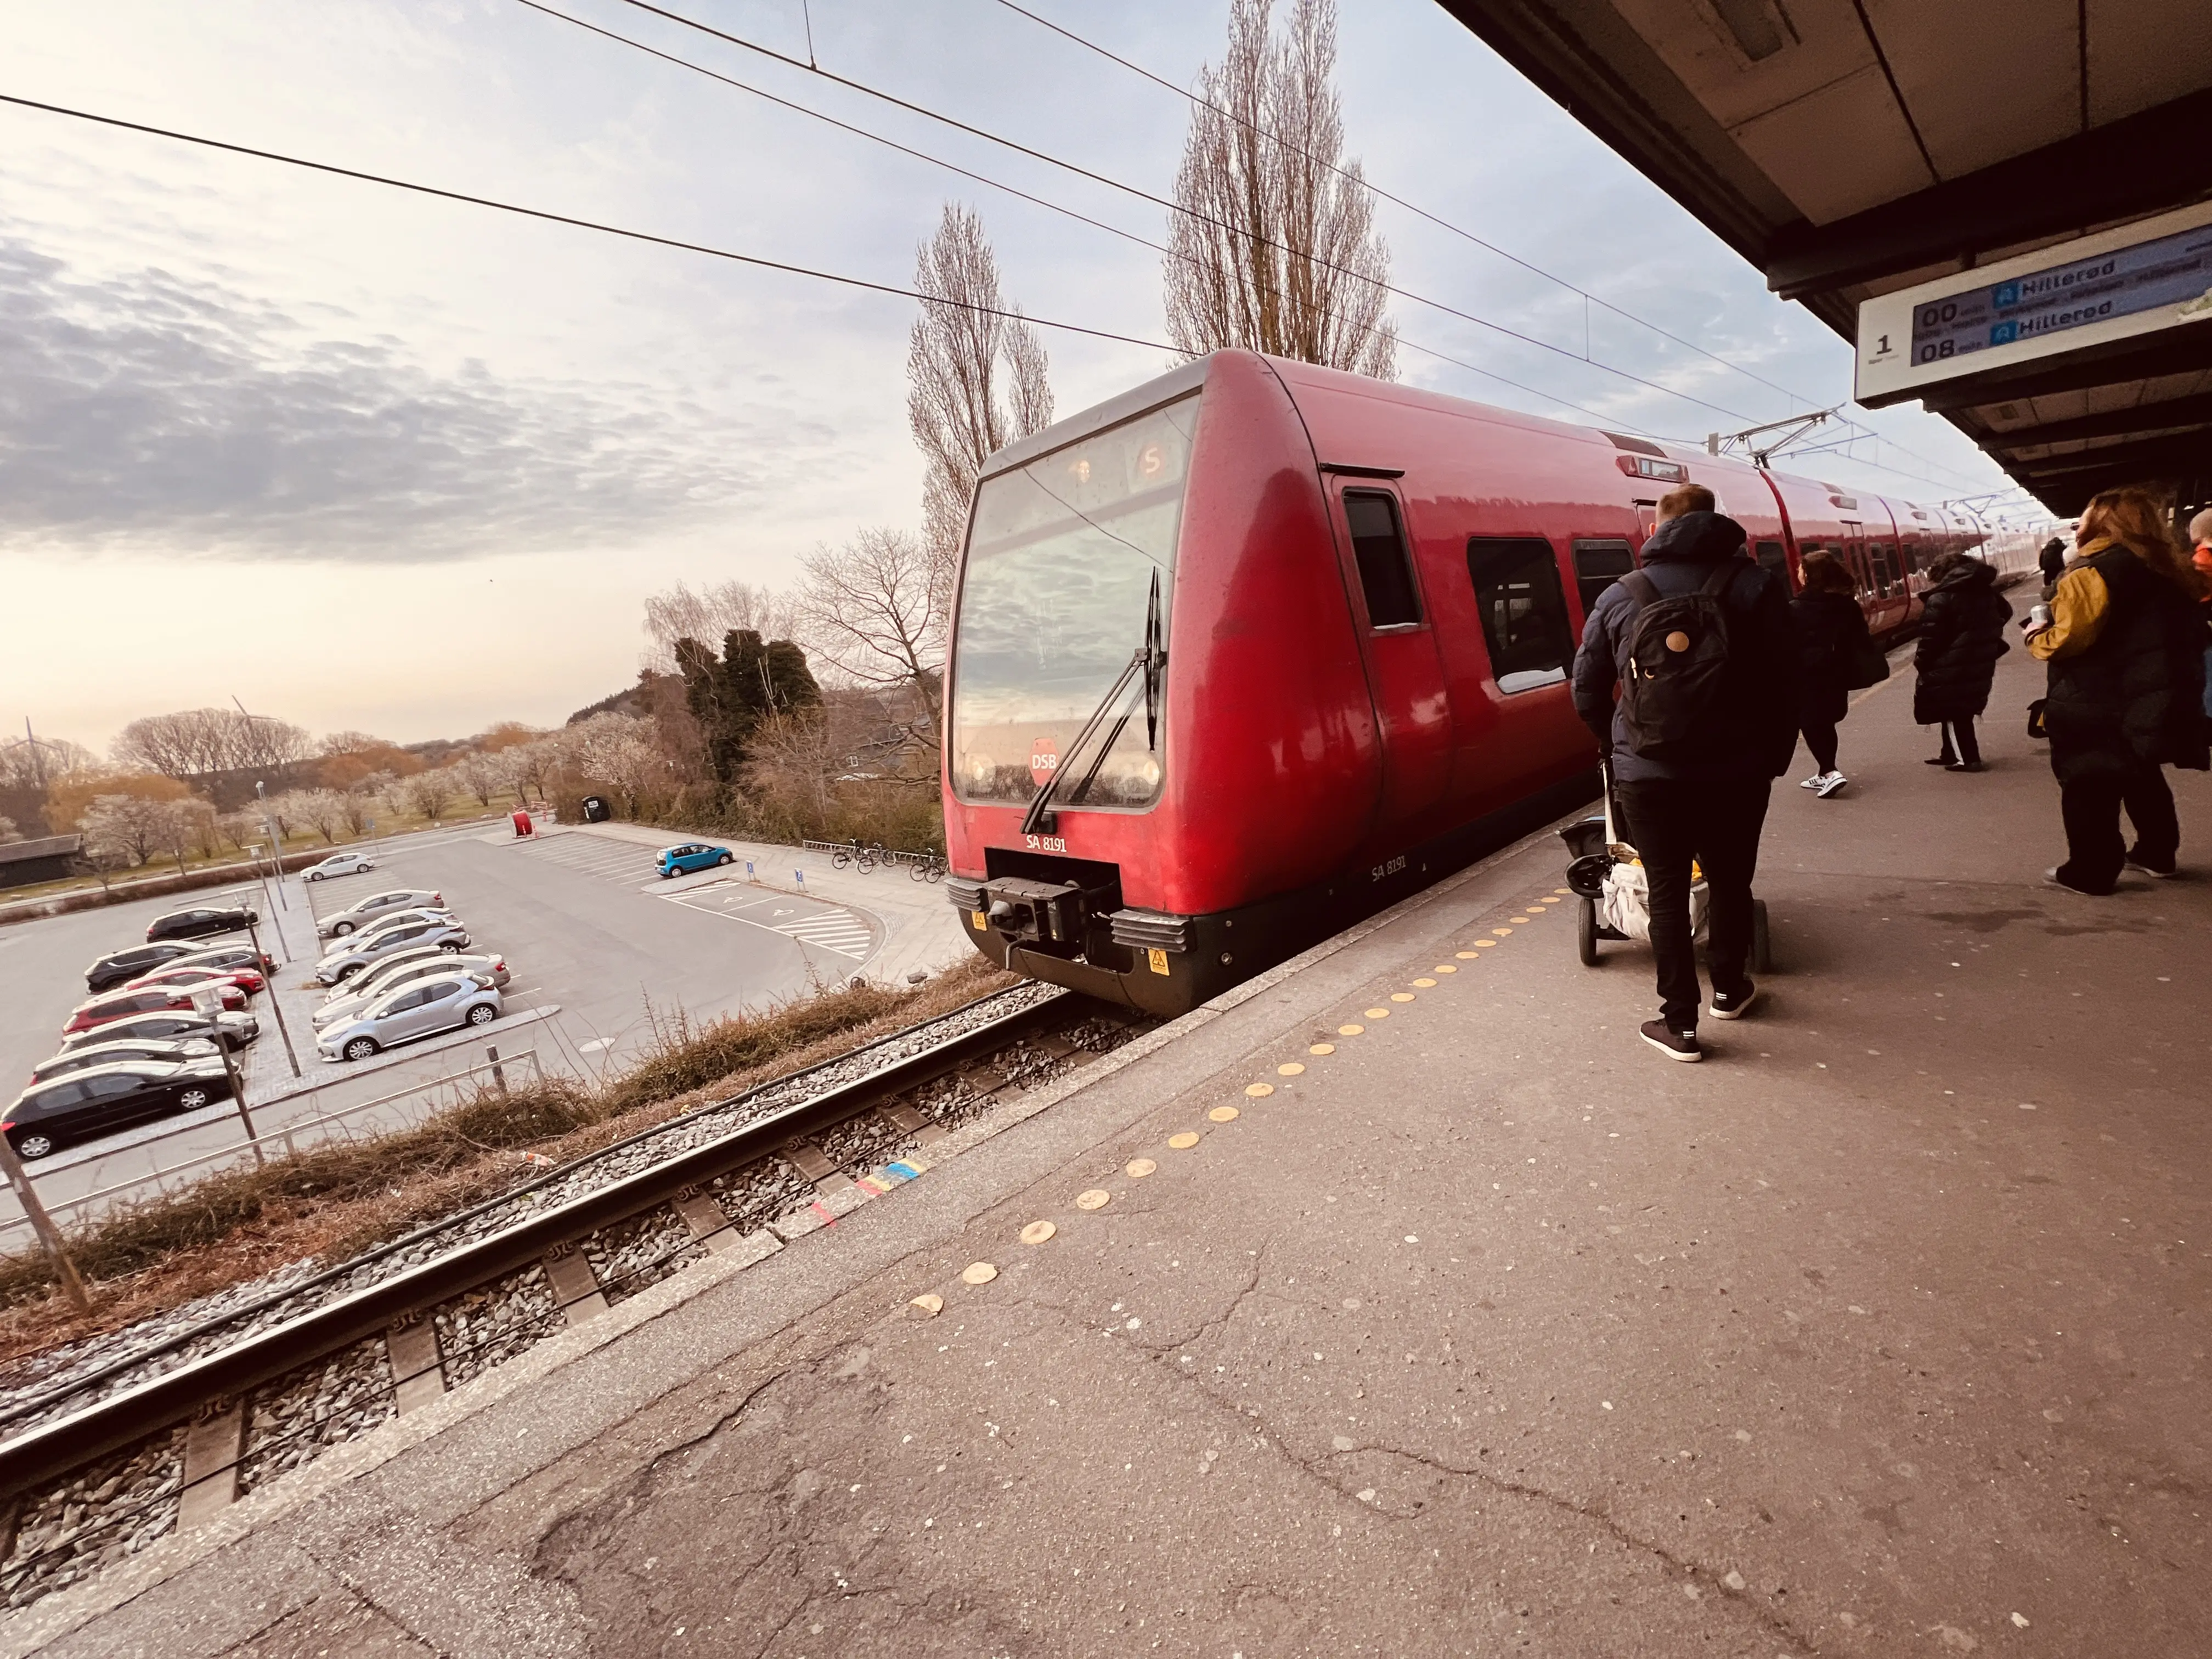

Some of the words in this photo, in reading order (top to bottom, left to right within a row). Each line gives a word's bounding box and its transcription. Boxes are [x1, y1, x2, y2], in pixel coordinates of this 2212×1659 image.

[1923, 303, 1957, 327] 00
[1876, 334, 1892, 356] 1
[1921, 339, 1955, 363] 08
[1144, 447, 1161, 473] S
[1032, 753, 1057, 770] DSB
[1026, 834, 1041, 850] SA
[1043, 836, 1067, 853] 8191
[1372, 865, 1385, 882] SA
[1387, 855, 1406, 874] 8191
